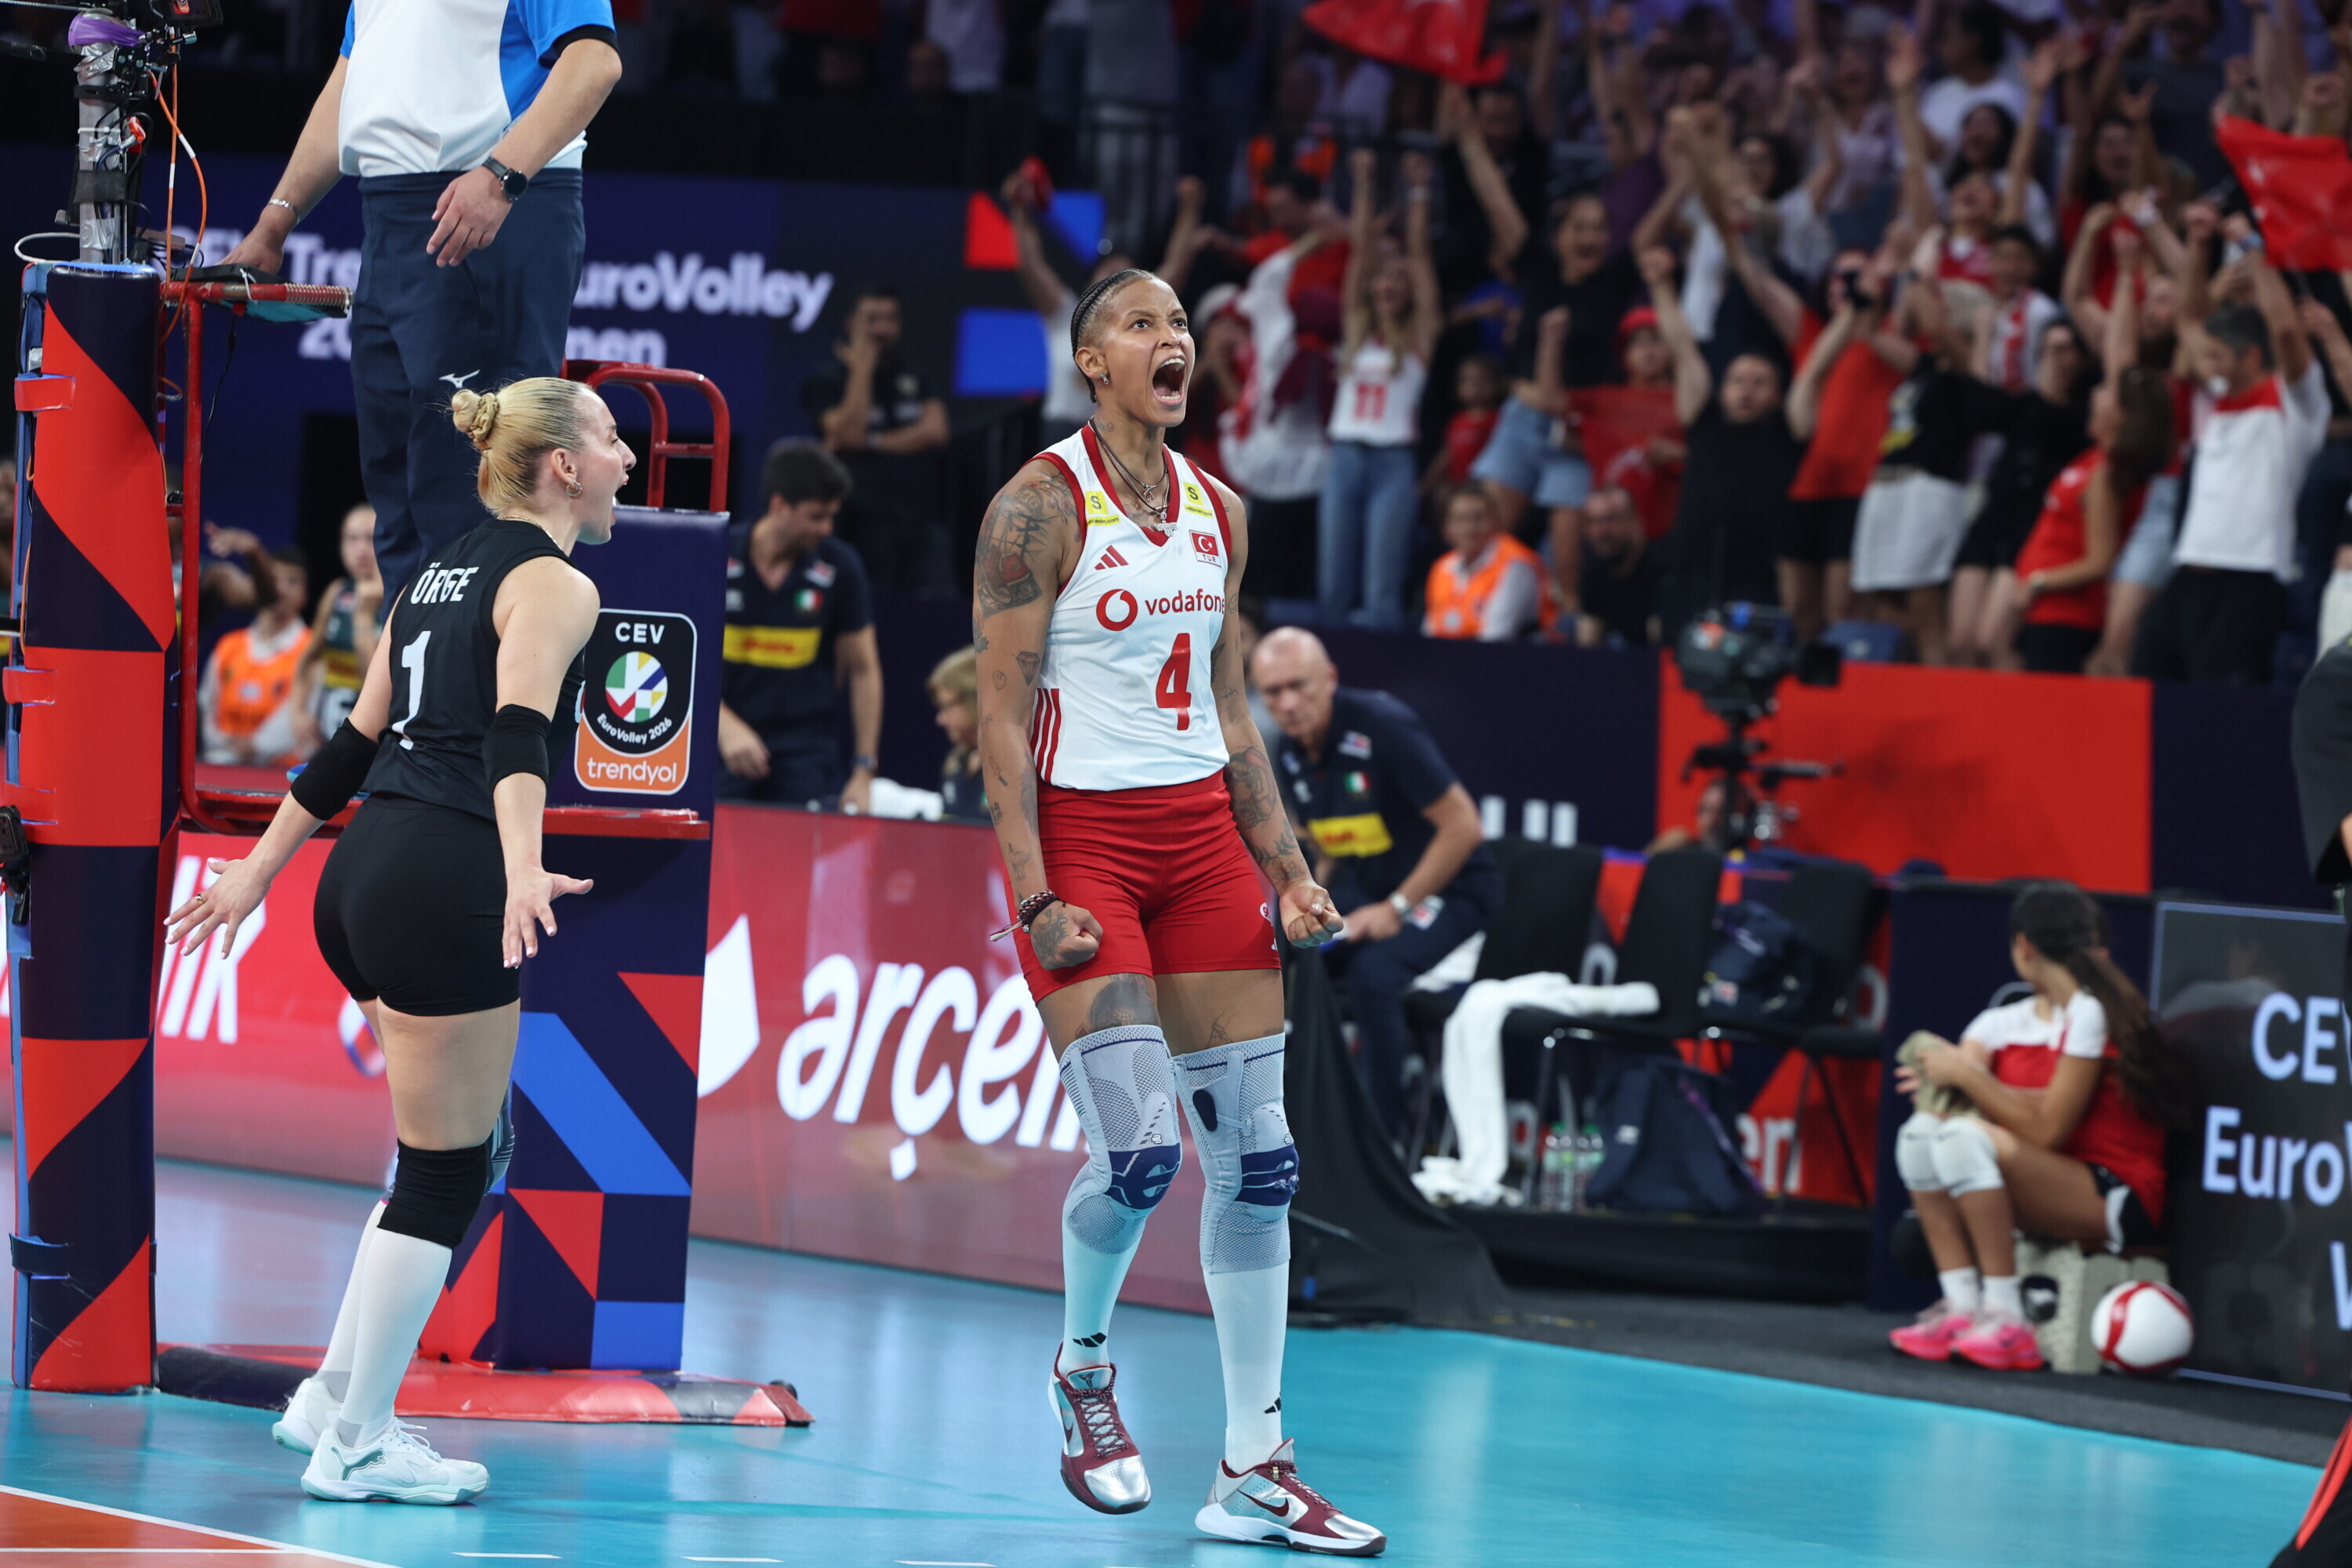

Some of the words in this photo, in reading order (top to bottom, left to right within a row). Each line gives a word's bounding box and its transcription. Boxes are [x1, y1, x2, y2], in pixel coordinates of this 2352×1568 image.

[572, 250, 834, 333] uroVolley
[1091, 495, 1102, 510] S
[1187, 486, 1200, 500] S
[1202, 554, 1217, 564] TUR
[411, 562, 479, 604] ÖRGE
[615, 622, 665, 644] CEV
[392, 630, 431, 750] 1
[1155, 633, 1192, 731] 4
[597, 713, 648, 746] EuroVolley
[648, 717, 673, 740] 2026
[586, 757, 677, 786] trendyol
[2252, 991, 2352, 1085] CE
[2201, 1105, 2352, 1207] Euro
